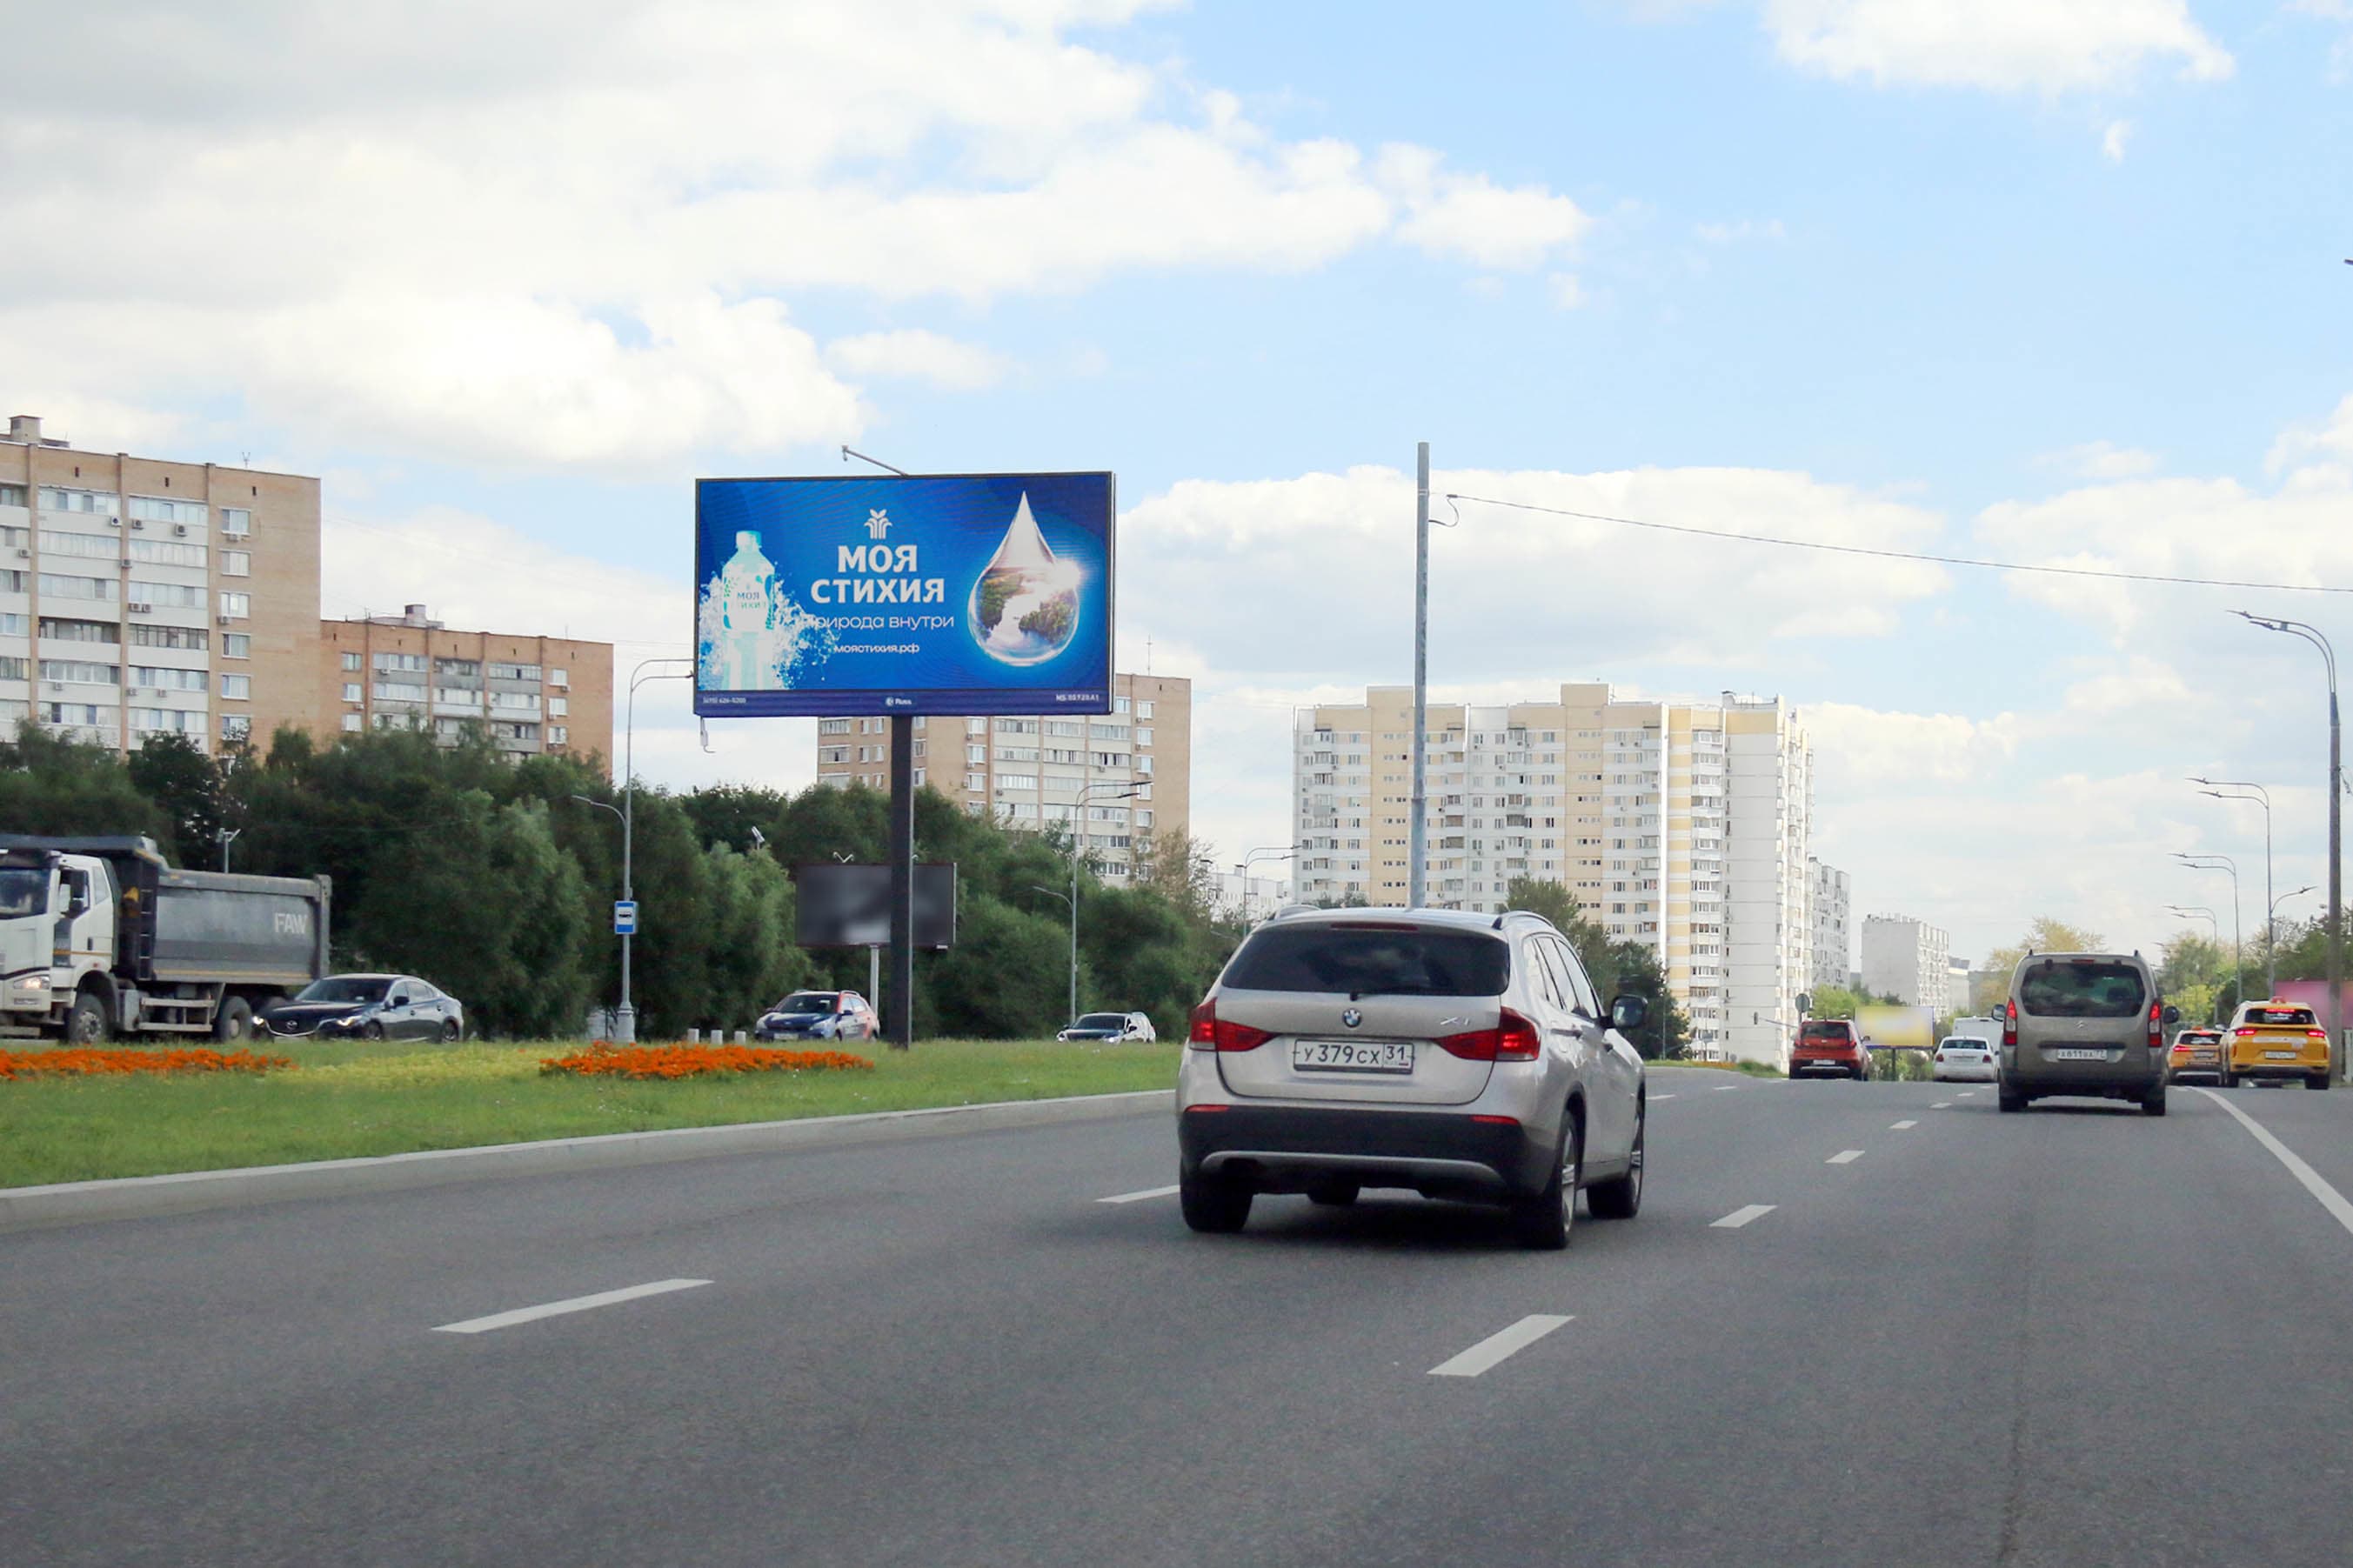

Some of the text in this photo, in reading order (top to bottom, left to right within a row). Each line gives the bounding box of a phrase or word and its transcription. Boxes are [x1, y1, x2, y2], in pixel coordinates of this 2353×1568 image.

[838, 544, 918, 573] МОЯ
[811, 578, 945, 604] СТИХИЯ
[807, 615, 954, 631] рирода внутри
[275, 913, 308, 934] FAW
[1386, 1045, 1405, 1060] 31
